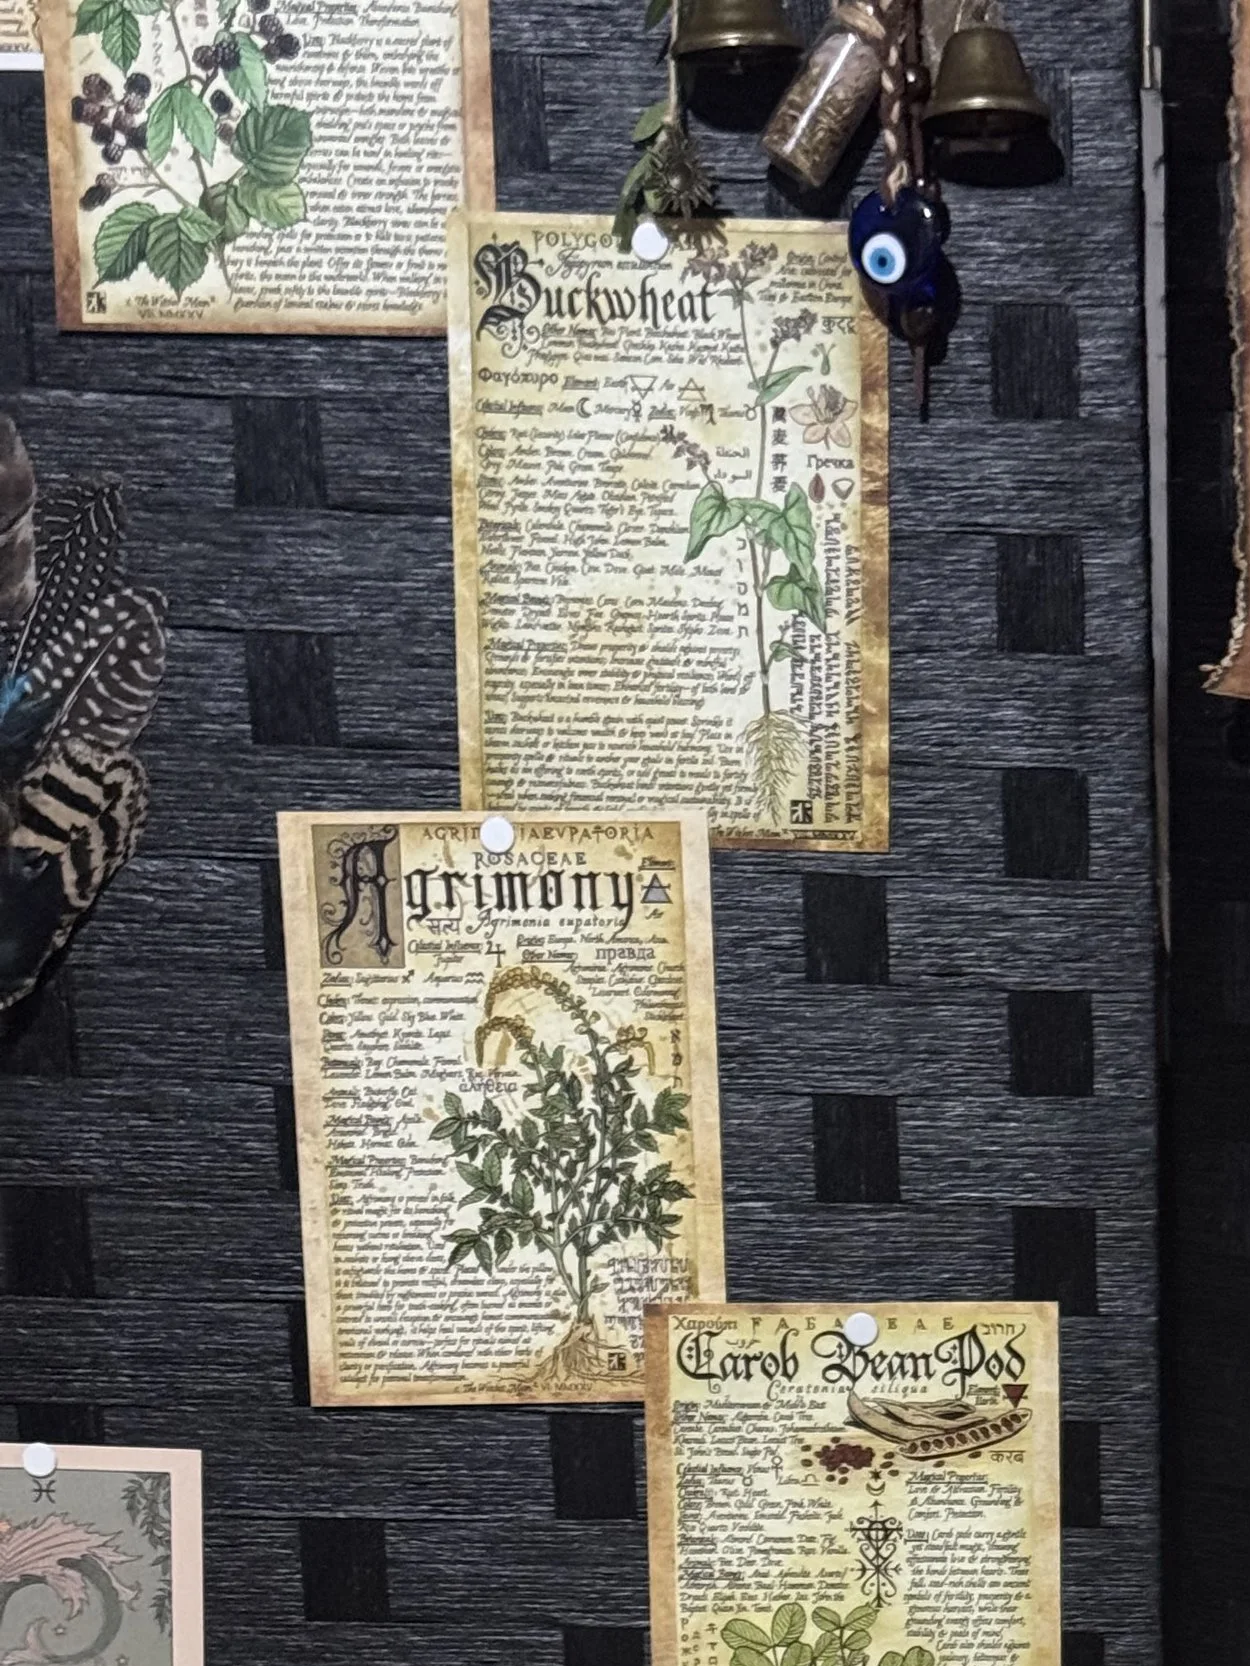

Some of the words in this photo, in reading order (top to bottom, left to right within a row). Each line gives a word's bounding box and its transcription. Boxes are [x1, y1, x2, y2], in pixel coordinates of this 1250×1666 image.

[474, 238, 718, 346] Buckwheat
[321, 825, 634, 965] Agrimony
[473, 851, 587, 869] ROSACEAE
[595, 947, 656, 964] правда
[676, 1328, 800, 1386] Carob
[811, 1330, 936, 1388] Bean
[934, 1323, 1027, 1400] Pod
